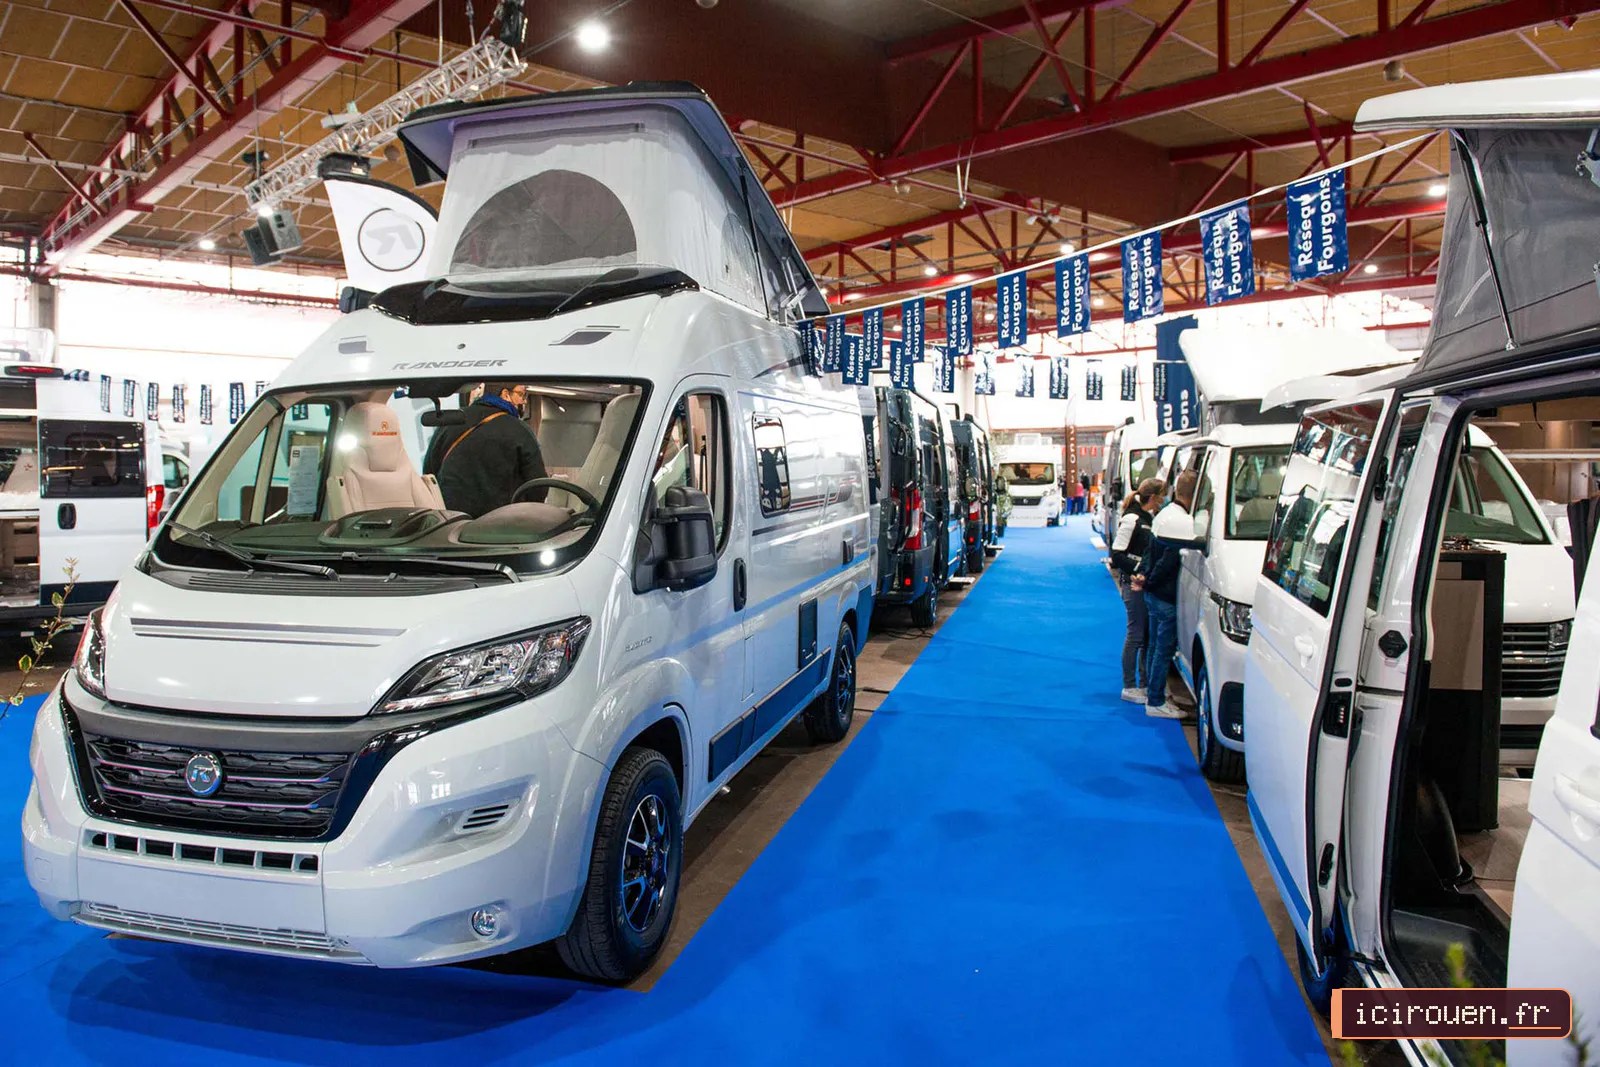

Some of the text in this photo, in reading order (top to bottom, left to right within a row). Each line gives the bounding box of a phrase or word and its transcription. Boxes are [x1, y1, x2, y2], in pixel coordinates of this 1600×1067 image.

[1228, 210, 1243, 296] Fourgons
[1317, 177, 1336, 272] Fourgons
[1128, 250, 1138, 311] Réseau
[1142, 237, 1155, 316] Fourgons
[1211, 224, 1225, 291] Réseau
[958, 290, 968, 353] Fourgons
[1001, 286, 1009, 339] Réseau
[1011, 276, 1022, 344] Fourgons
[1060, 270, 1070, 327] Réseau
[1072, 259, 1085, 332] Fourgons
[833, 318, 841, 370] Fourgons
[847, 342, 855, 378] Réseau
[871, 311, 879, 366] Fourgons
[913, 302, 921, 360] Fourgons
[391, 359, 508, 370] RANDGER
